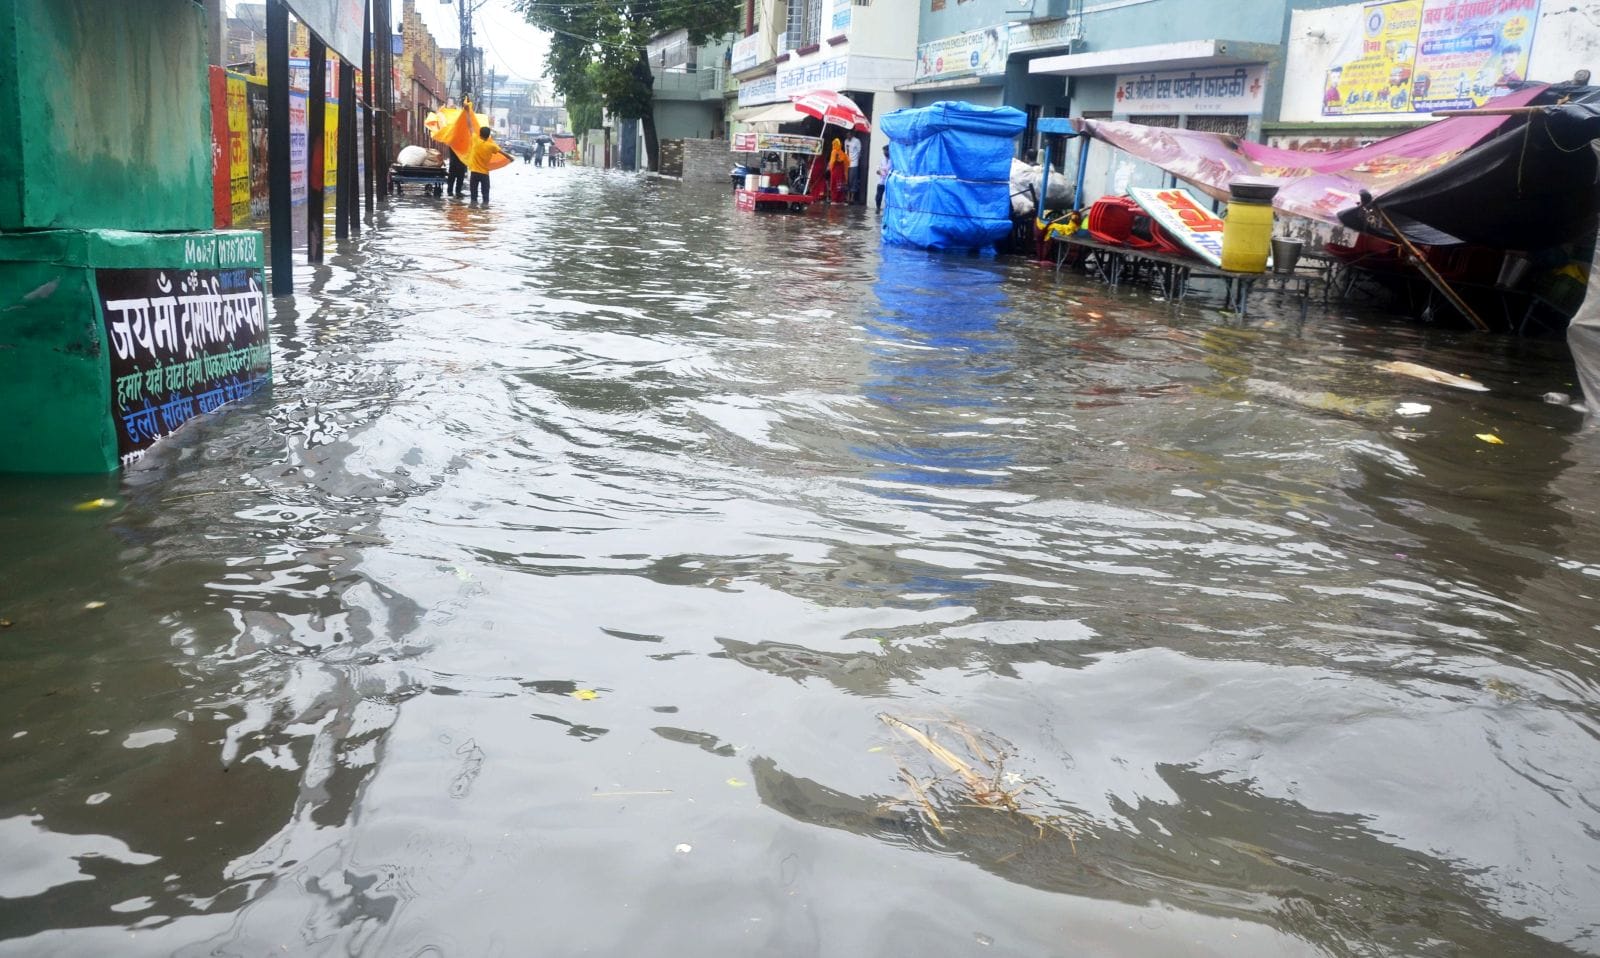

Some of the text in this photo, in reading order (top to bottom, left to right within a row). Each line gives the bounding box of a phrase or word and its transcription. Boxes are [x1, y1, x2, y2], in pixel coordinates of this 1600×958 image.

[106, 298, 156, 360] जय
[151, 272, 178, 354] माँ
[116, 365, 143, 412] हमारे
[145, 357, 163, 401] यहाँ
[122, 397, 159, 443] डेली
